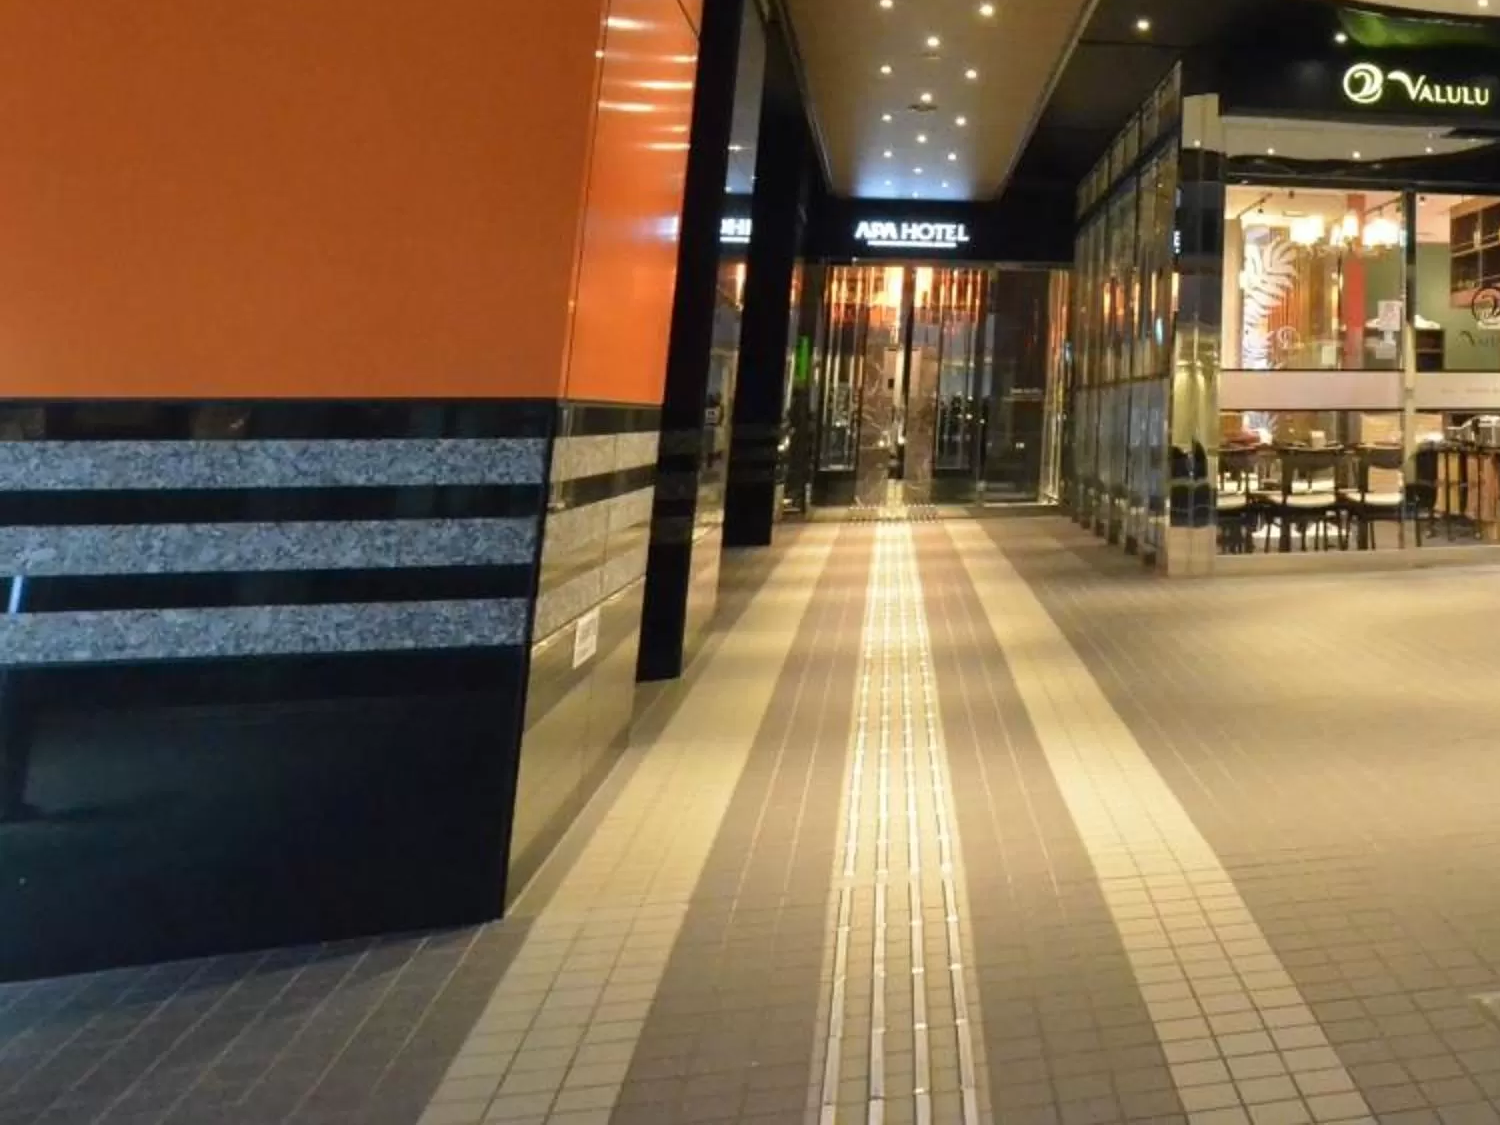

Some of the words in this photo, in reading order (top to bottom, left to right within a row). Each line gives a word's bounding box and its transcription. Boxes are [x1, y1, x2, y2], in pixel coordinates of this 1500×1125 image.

[1387, 70, 1490, 106] VALULU
[854, 220, 899, 240] APA
[900, 221, 971, 242] HOTEL
